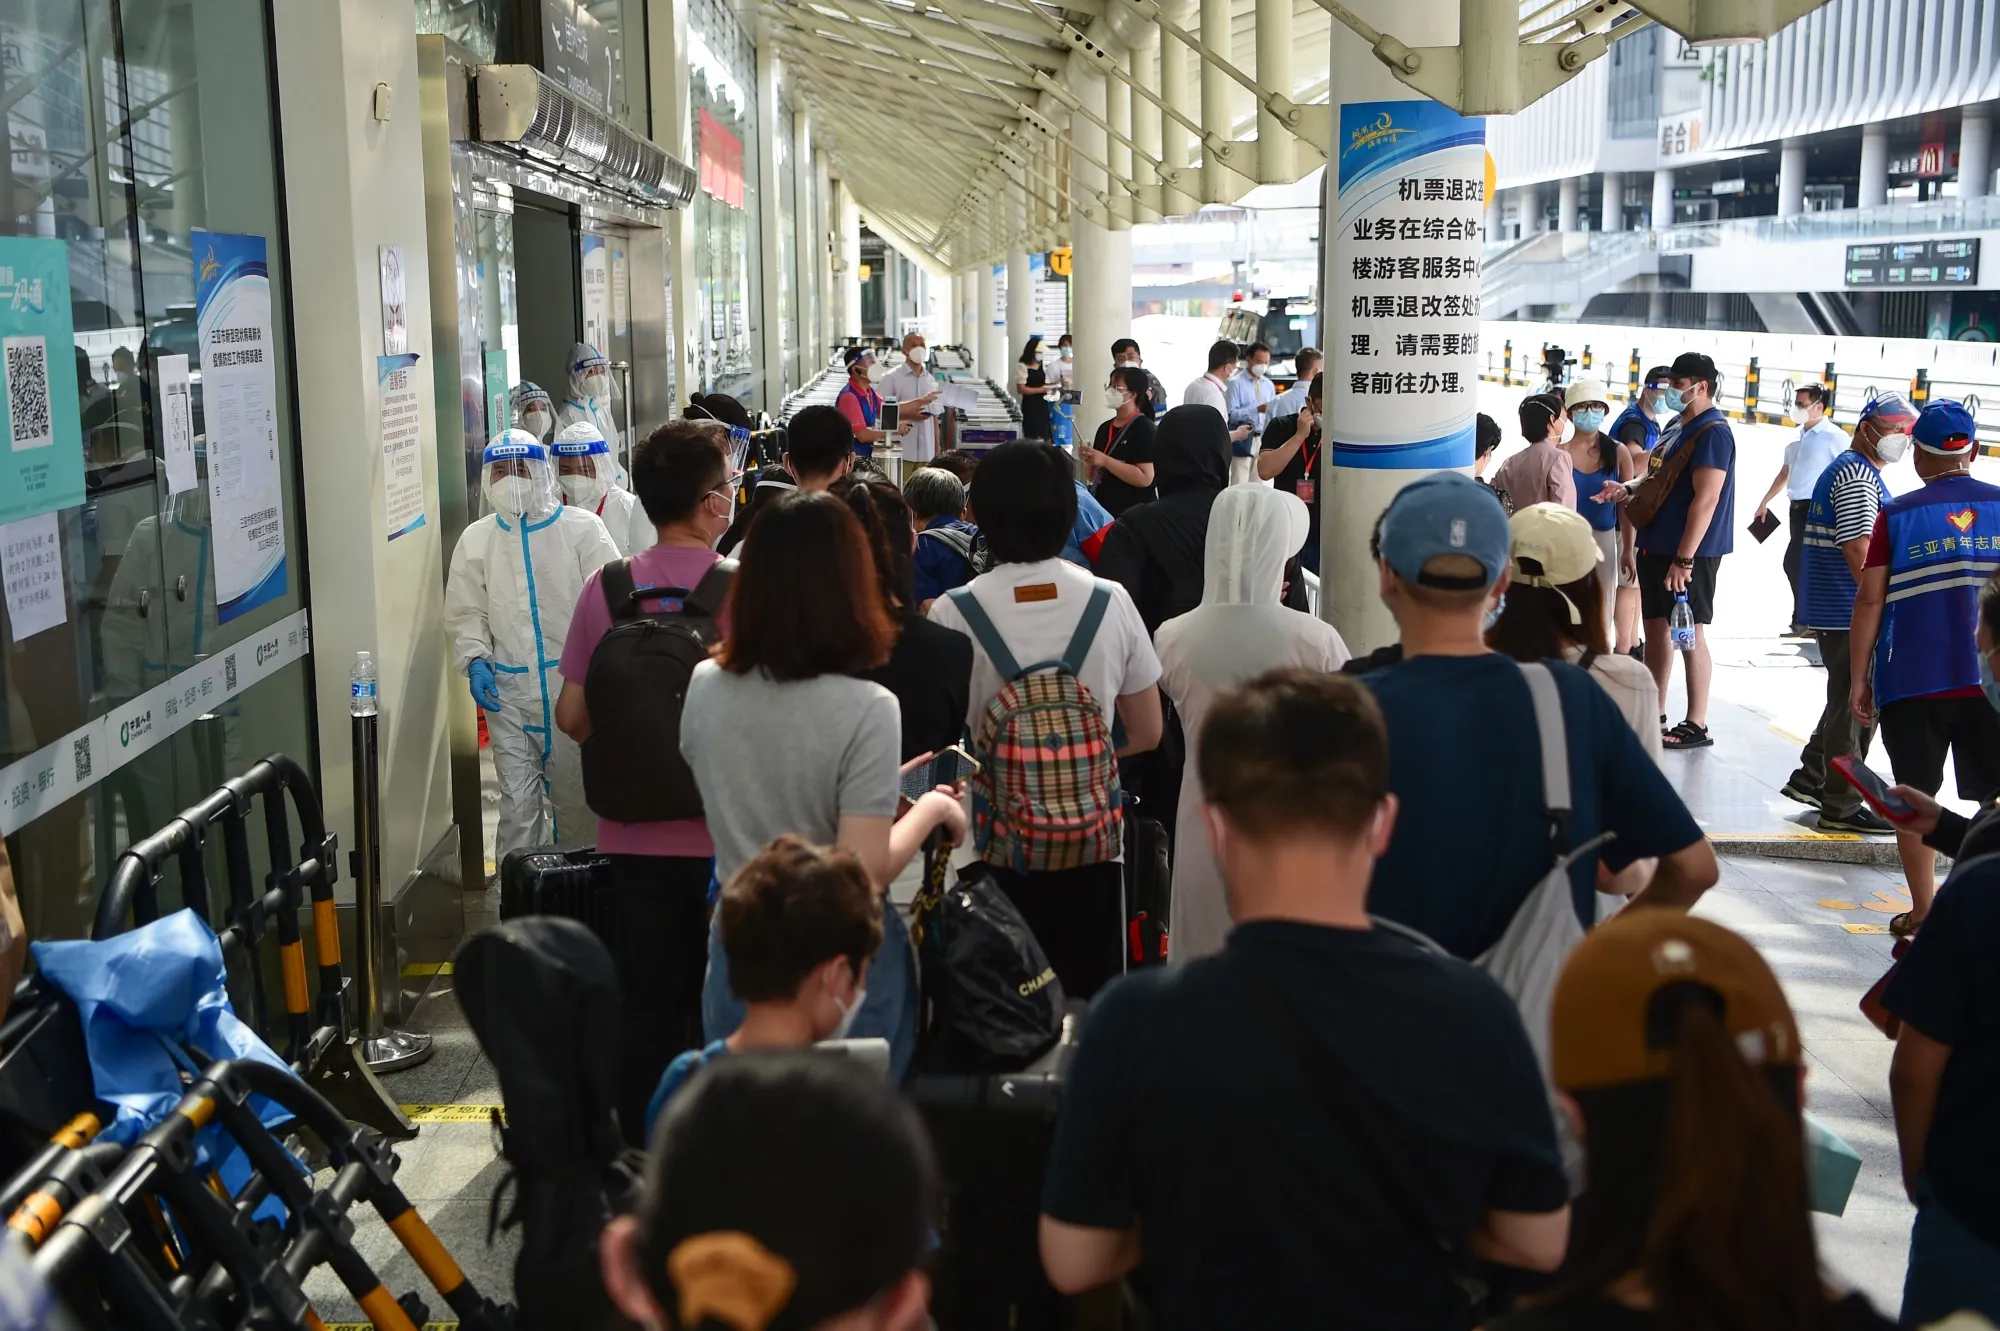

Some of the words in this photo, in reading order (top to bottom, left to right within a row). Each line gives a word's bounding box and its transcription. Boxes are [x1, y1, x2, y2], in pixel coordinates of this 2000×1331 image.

[1350, 371, 1464, 395] 客前往办理。
